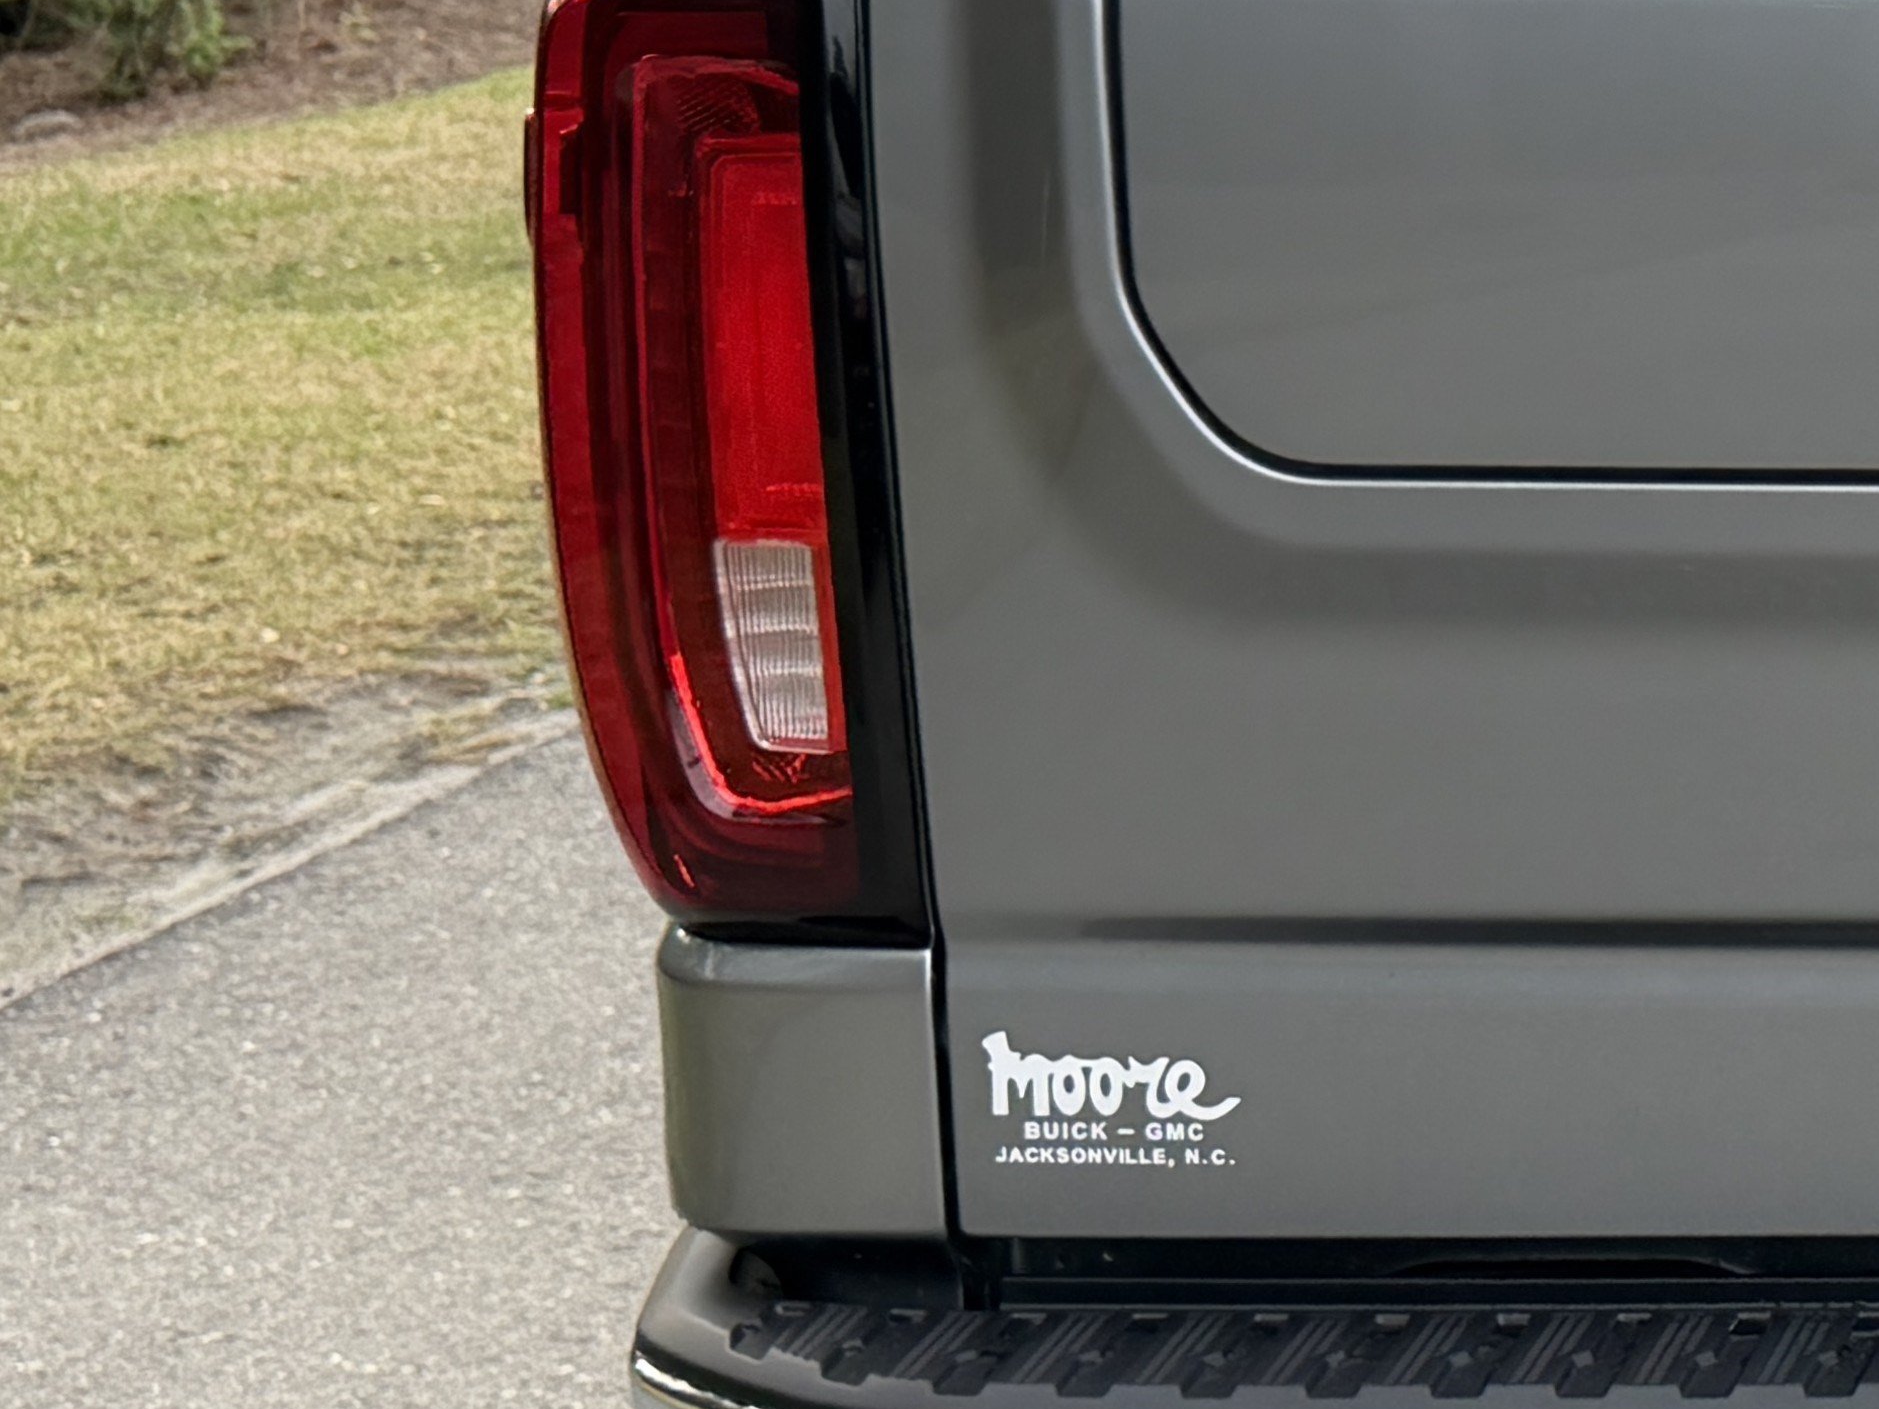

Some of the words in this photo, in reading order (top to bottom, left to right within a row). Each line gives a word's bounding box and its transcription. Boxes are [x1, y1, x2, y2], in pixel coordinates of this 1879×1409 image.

[1023, 1121, 1108, 1141] BUICK
[1145, 1122, 1204, 1142] GMC
[995, 1146, 1176, 1168] JACKSONVILLE,
[1185, 1147, 1236, 1166] N.C.
